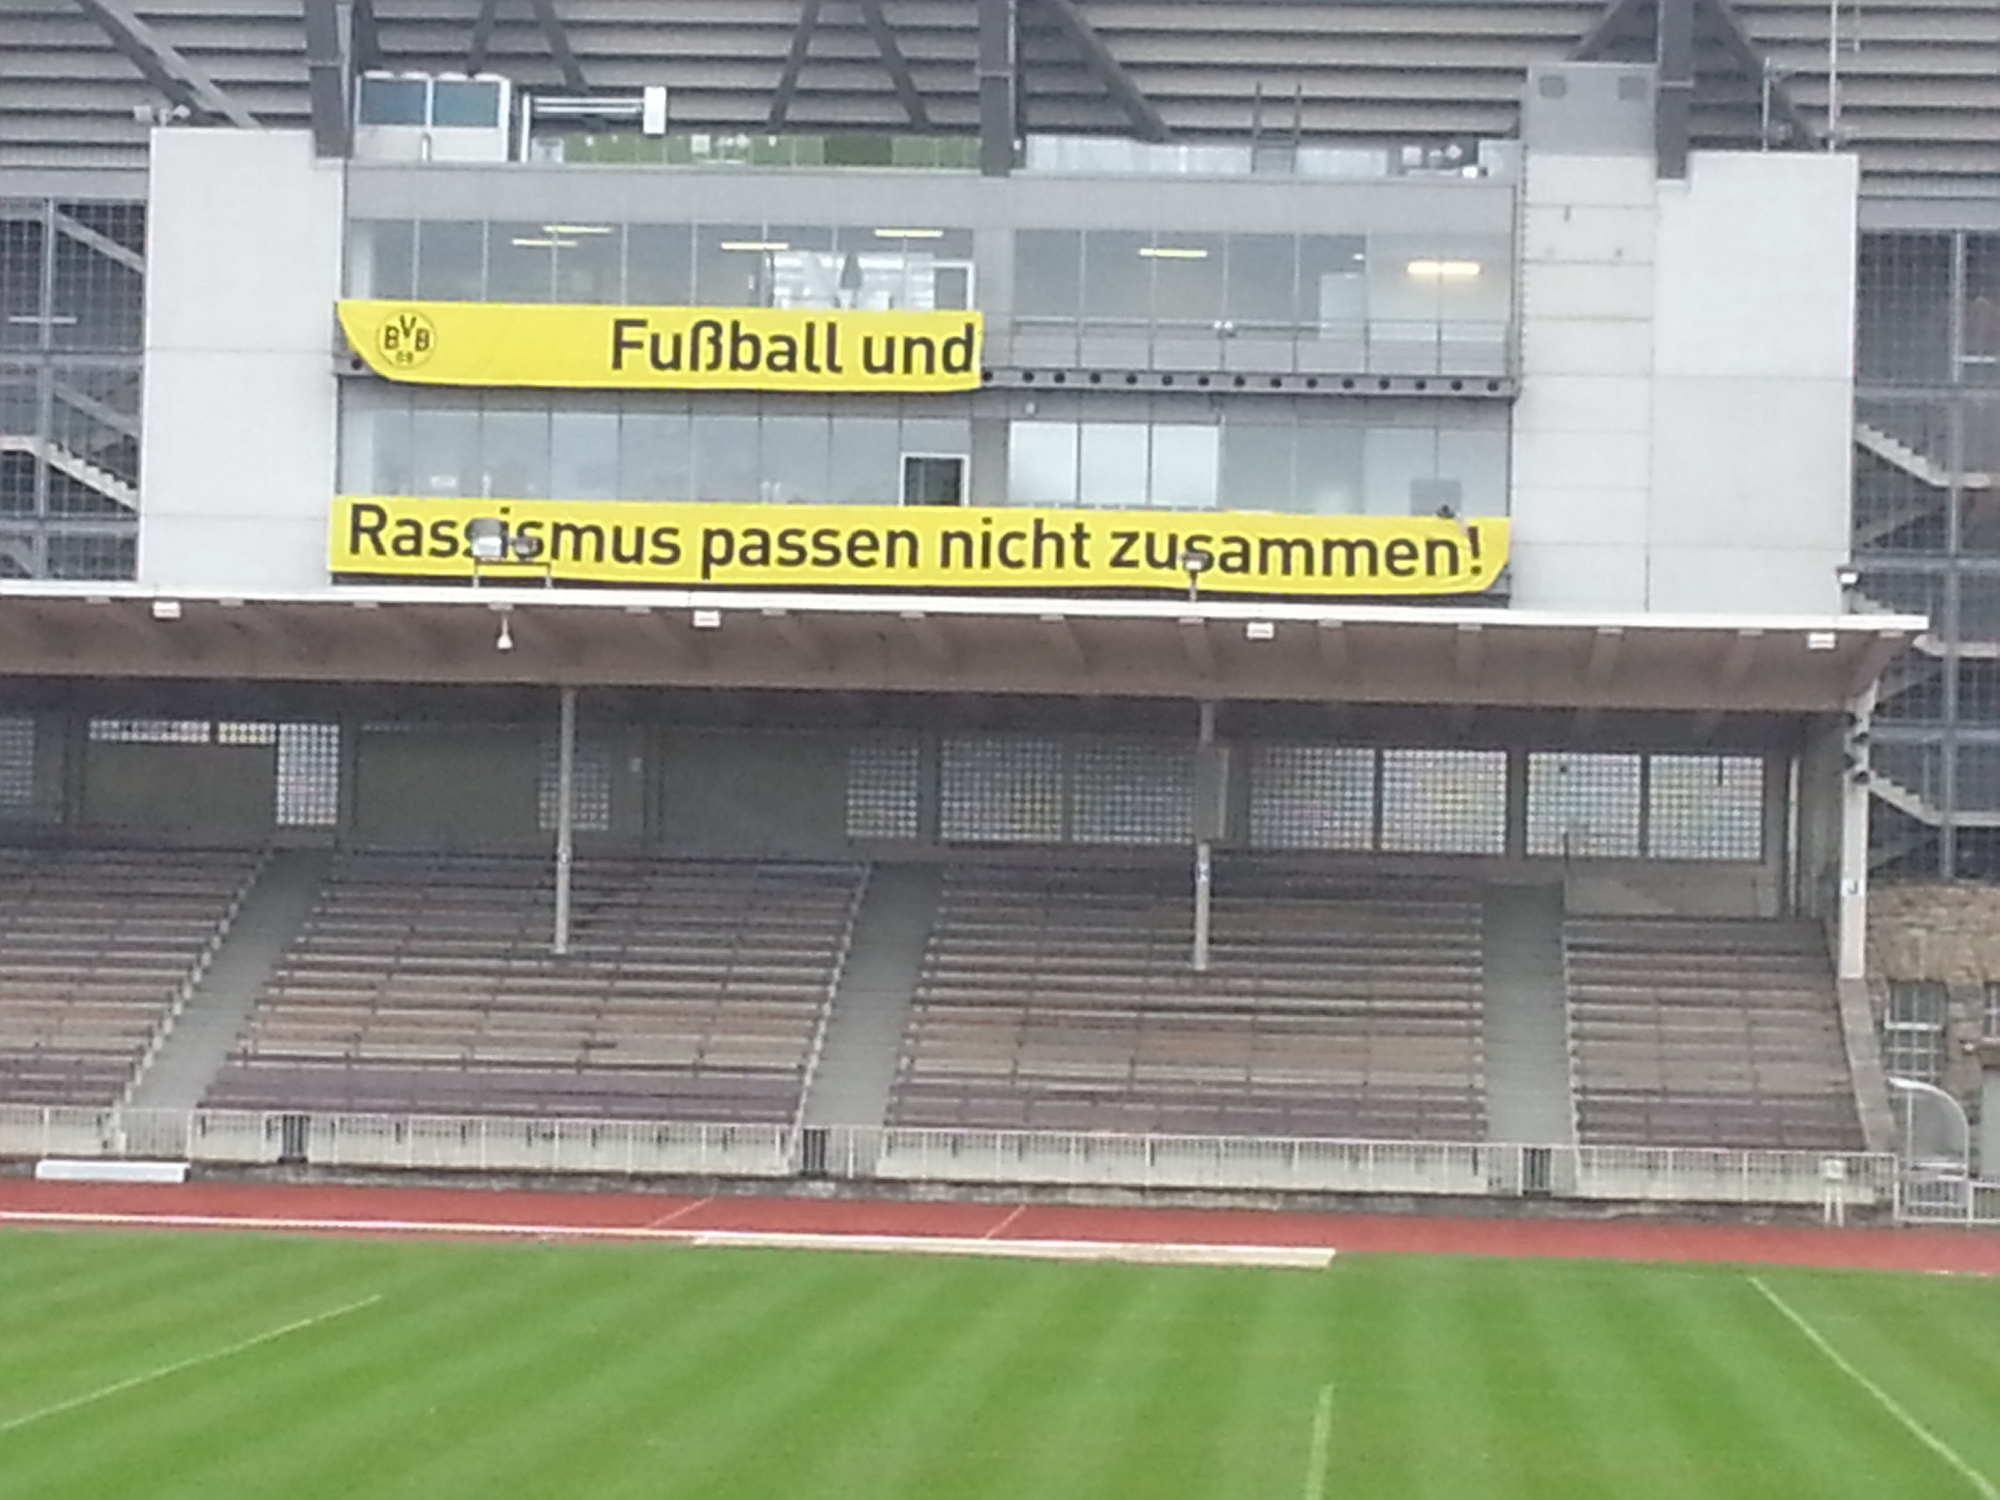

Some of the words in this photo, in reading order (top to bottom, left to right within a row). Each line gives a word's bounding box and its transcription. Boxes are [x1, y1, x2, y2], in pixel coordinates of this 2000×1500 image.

[384, 314, 430, 352] BVB
[612, 318, 844, 374] Fußball
[863, 322, 976, 374] und
[701, 527, 919, 580] passen
[940, 517, 1091, 569] nicht
[1109, 526, 1482, 577] zusammen!
